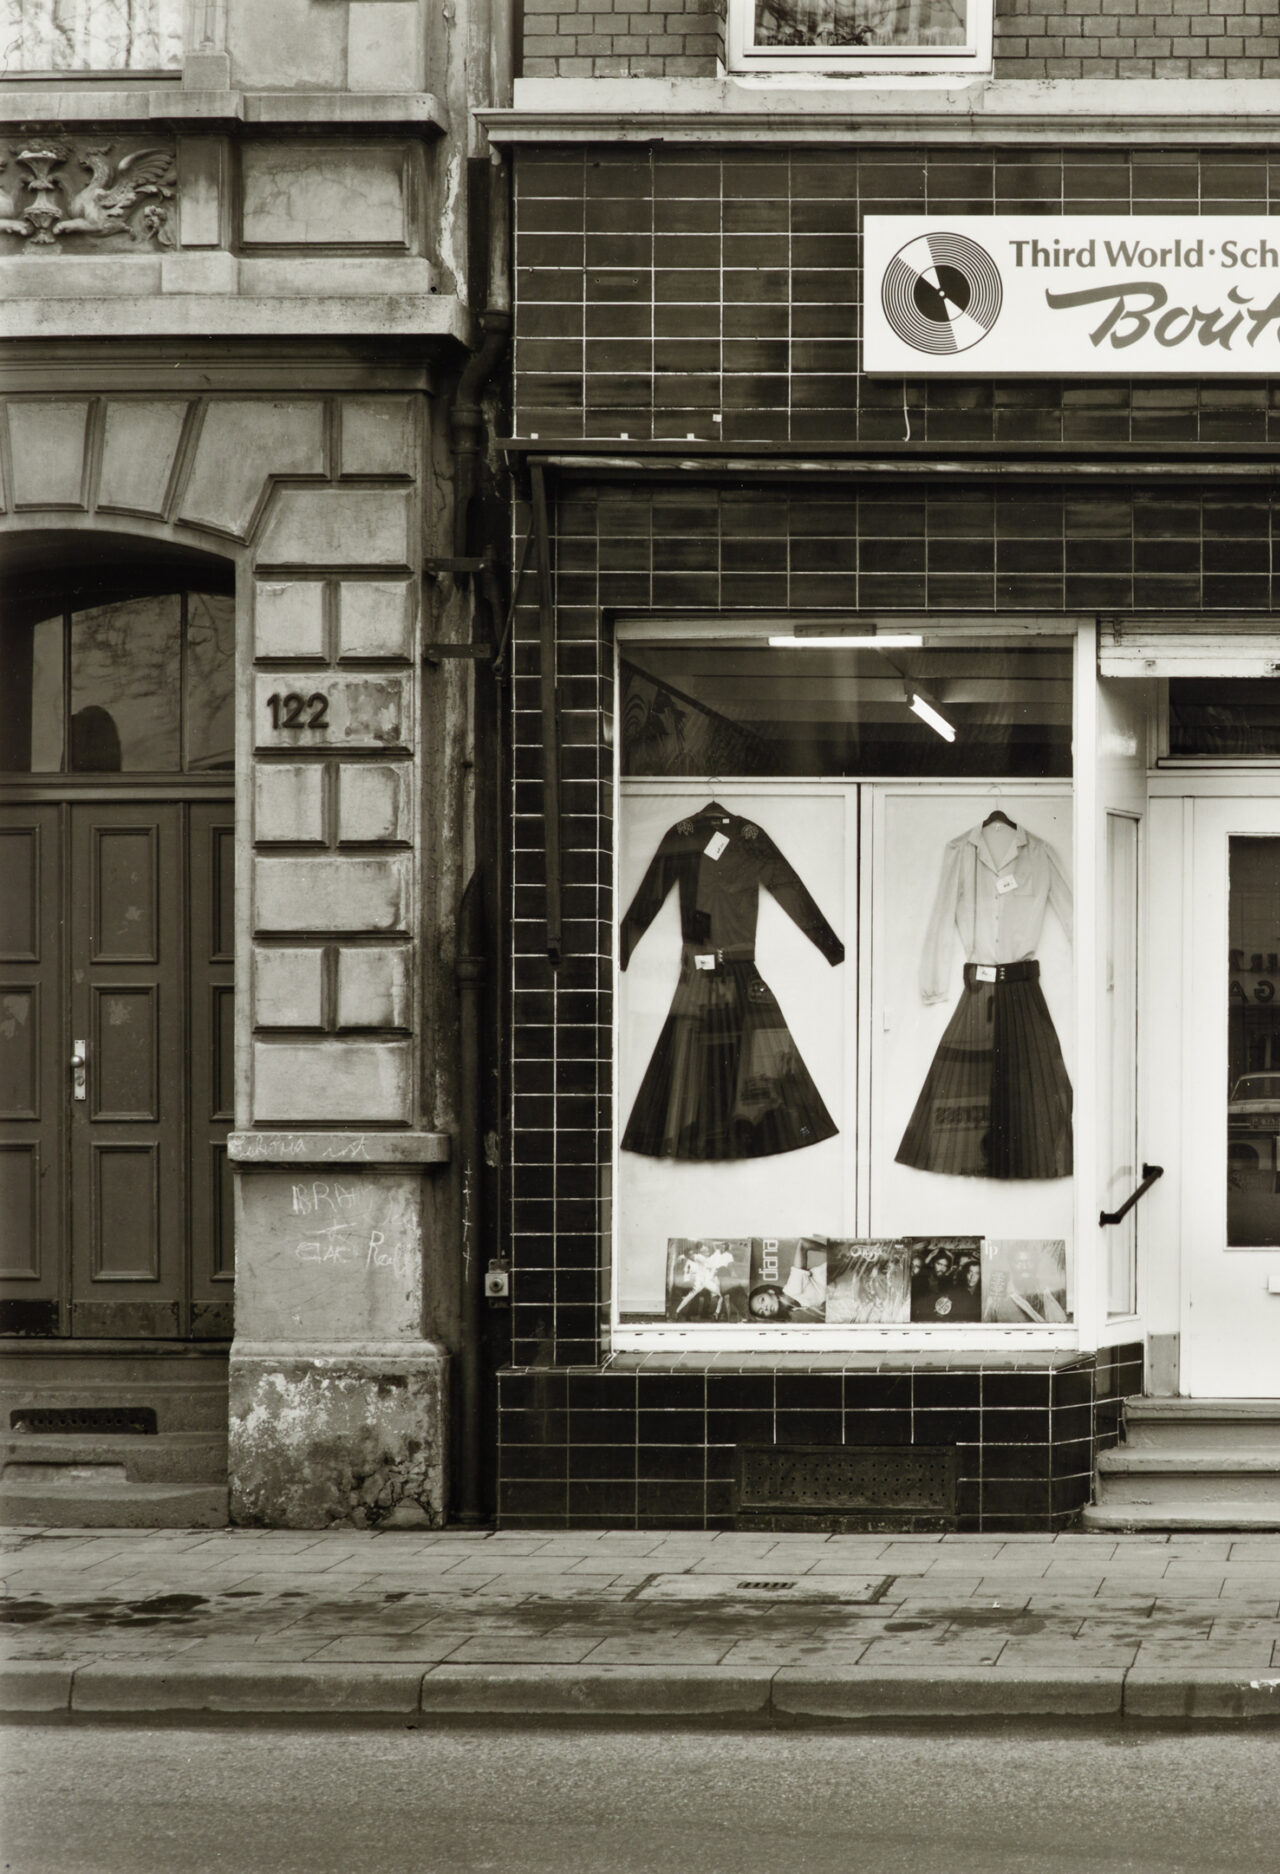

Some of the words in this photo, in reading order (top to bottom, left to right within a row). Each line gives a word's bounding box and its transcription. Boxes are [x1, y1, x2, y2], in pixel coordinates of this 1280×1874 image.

[1009, 239, 1095, 268] Third
[1104, 240, 1203, 268] World
[266, 691, 329, 730] 122
[758, 1239, 779, 1282] diana
